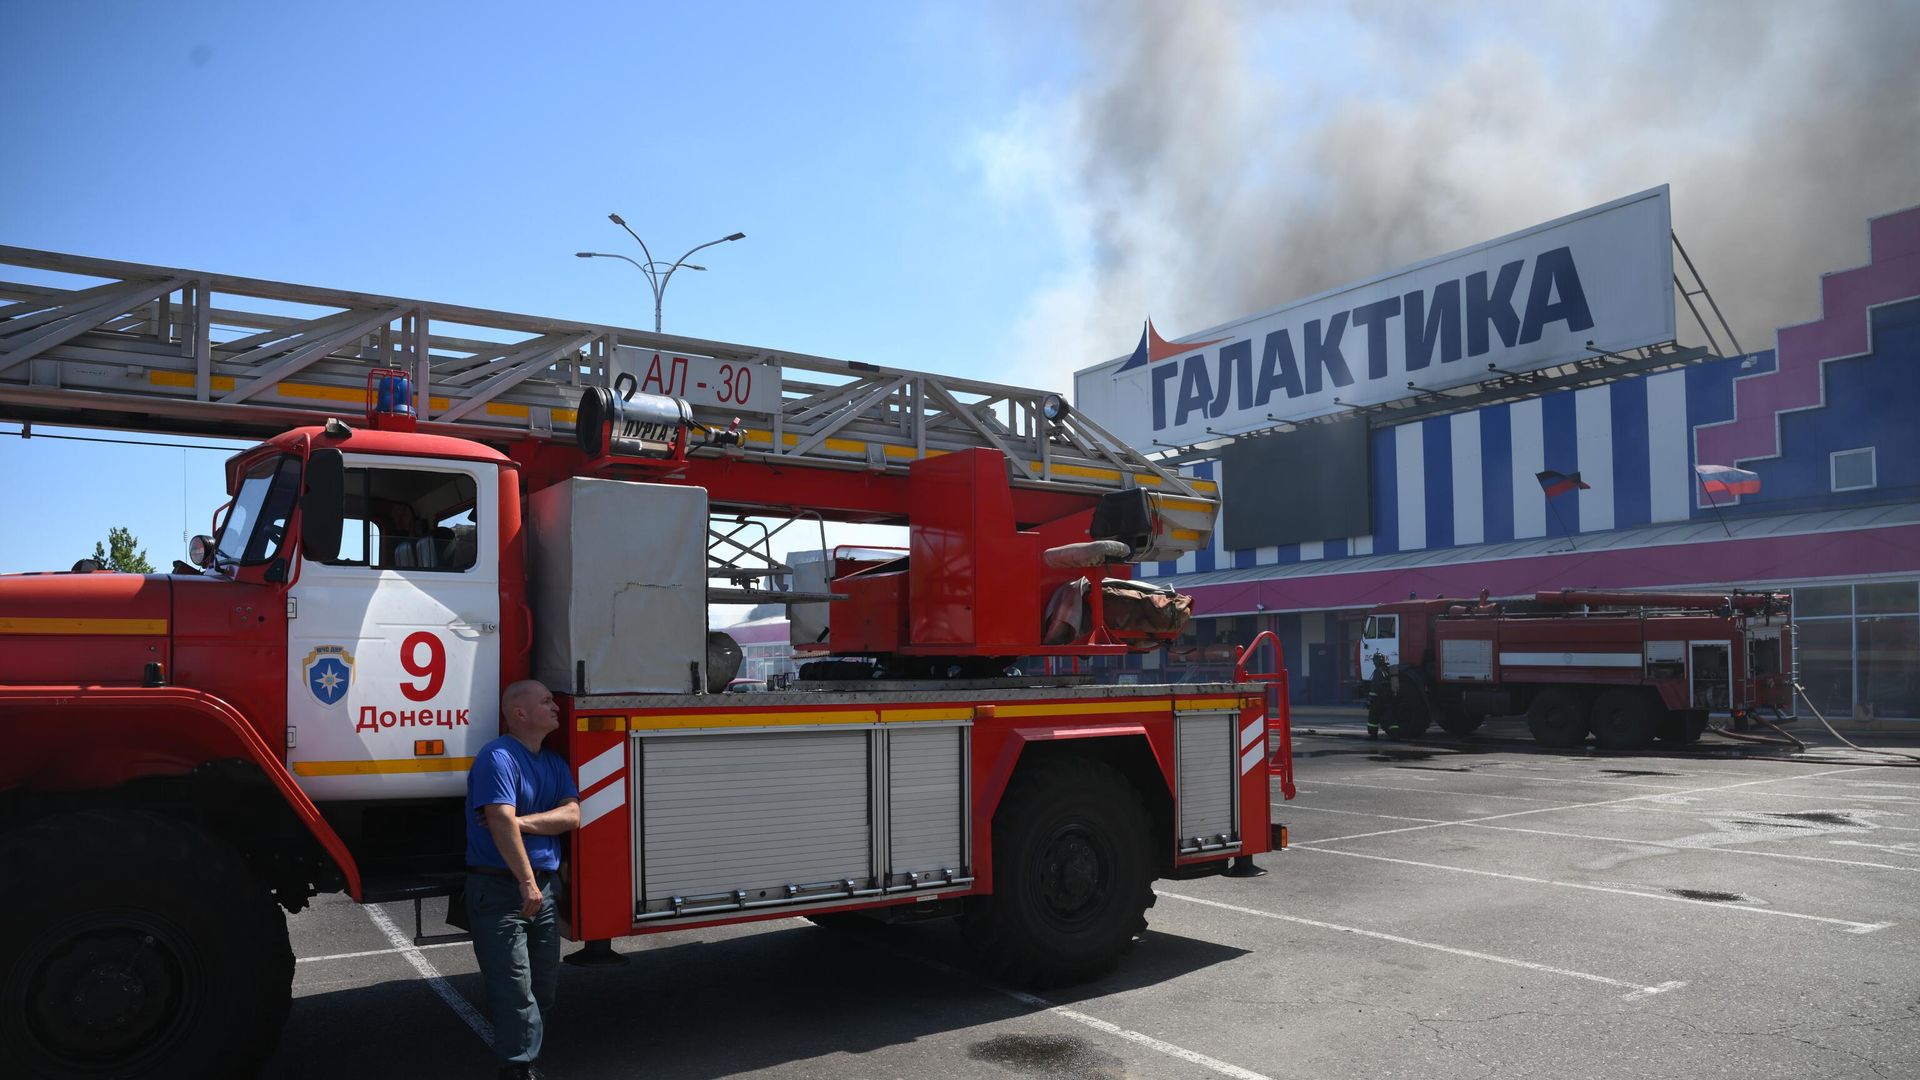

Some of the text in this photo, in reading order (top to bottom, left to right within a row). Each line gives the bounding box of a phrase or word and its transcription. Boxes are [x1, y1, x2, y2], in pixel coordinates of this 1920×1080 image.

[1151, 246, 1594, 431] ГАЛАКТИКА
[641, 354, 689, 397] АЛ
[716, 364, 751, 405] 30
[622, 419, 668, 441] ПУРГА
[400, 631, 446, 702] 9
[356, 706, 469, 733] Донецк
